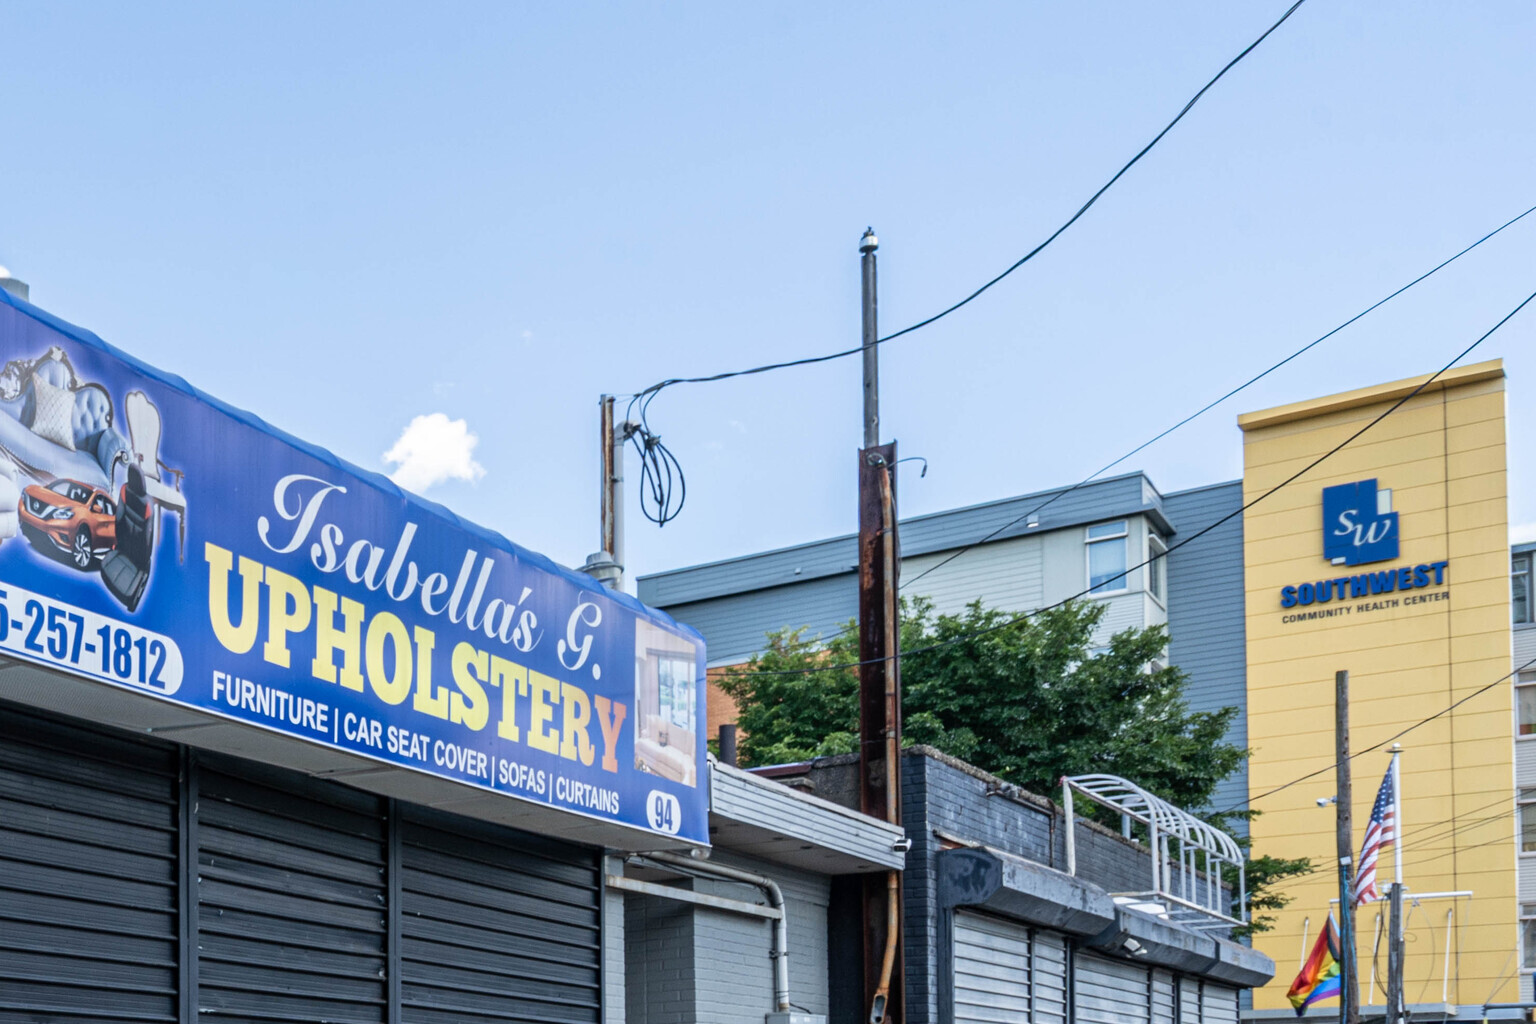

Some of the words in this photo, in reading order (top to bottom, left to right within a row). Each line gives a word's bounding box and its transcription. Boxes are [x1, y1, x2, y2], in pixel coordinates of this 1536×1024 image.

[257, 474, 544, 653] Isabella's
[558, 590, 603, 680] G.
[1280, 561, 1449, 608] SOUTHWEST
[1282, 605, 1352, 624] COMMUNITY
[1357, 598, 1400, 613] HEALTH
[1403, 591, 1450, 606] CENTER
[204, 541, 627, 774] UPHOLSTERY
[212, 670, 329, 734] FURNITURE
[343, 711, 383, 748] CAR
[387, 727, 430, 763] SEAT
[433, 739, 488, 780] COVER
[498, 760, 547, 796] SOFAS
[555, 776, 620, 815] CURTAINS
[653, 795, 674, 831] 94
